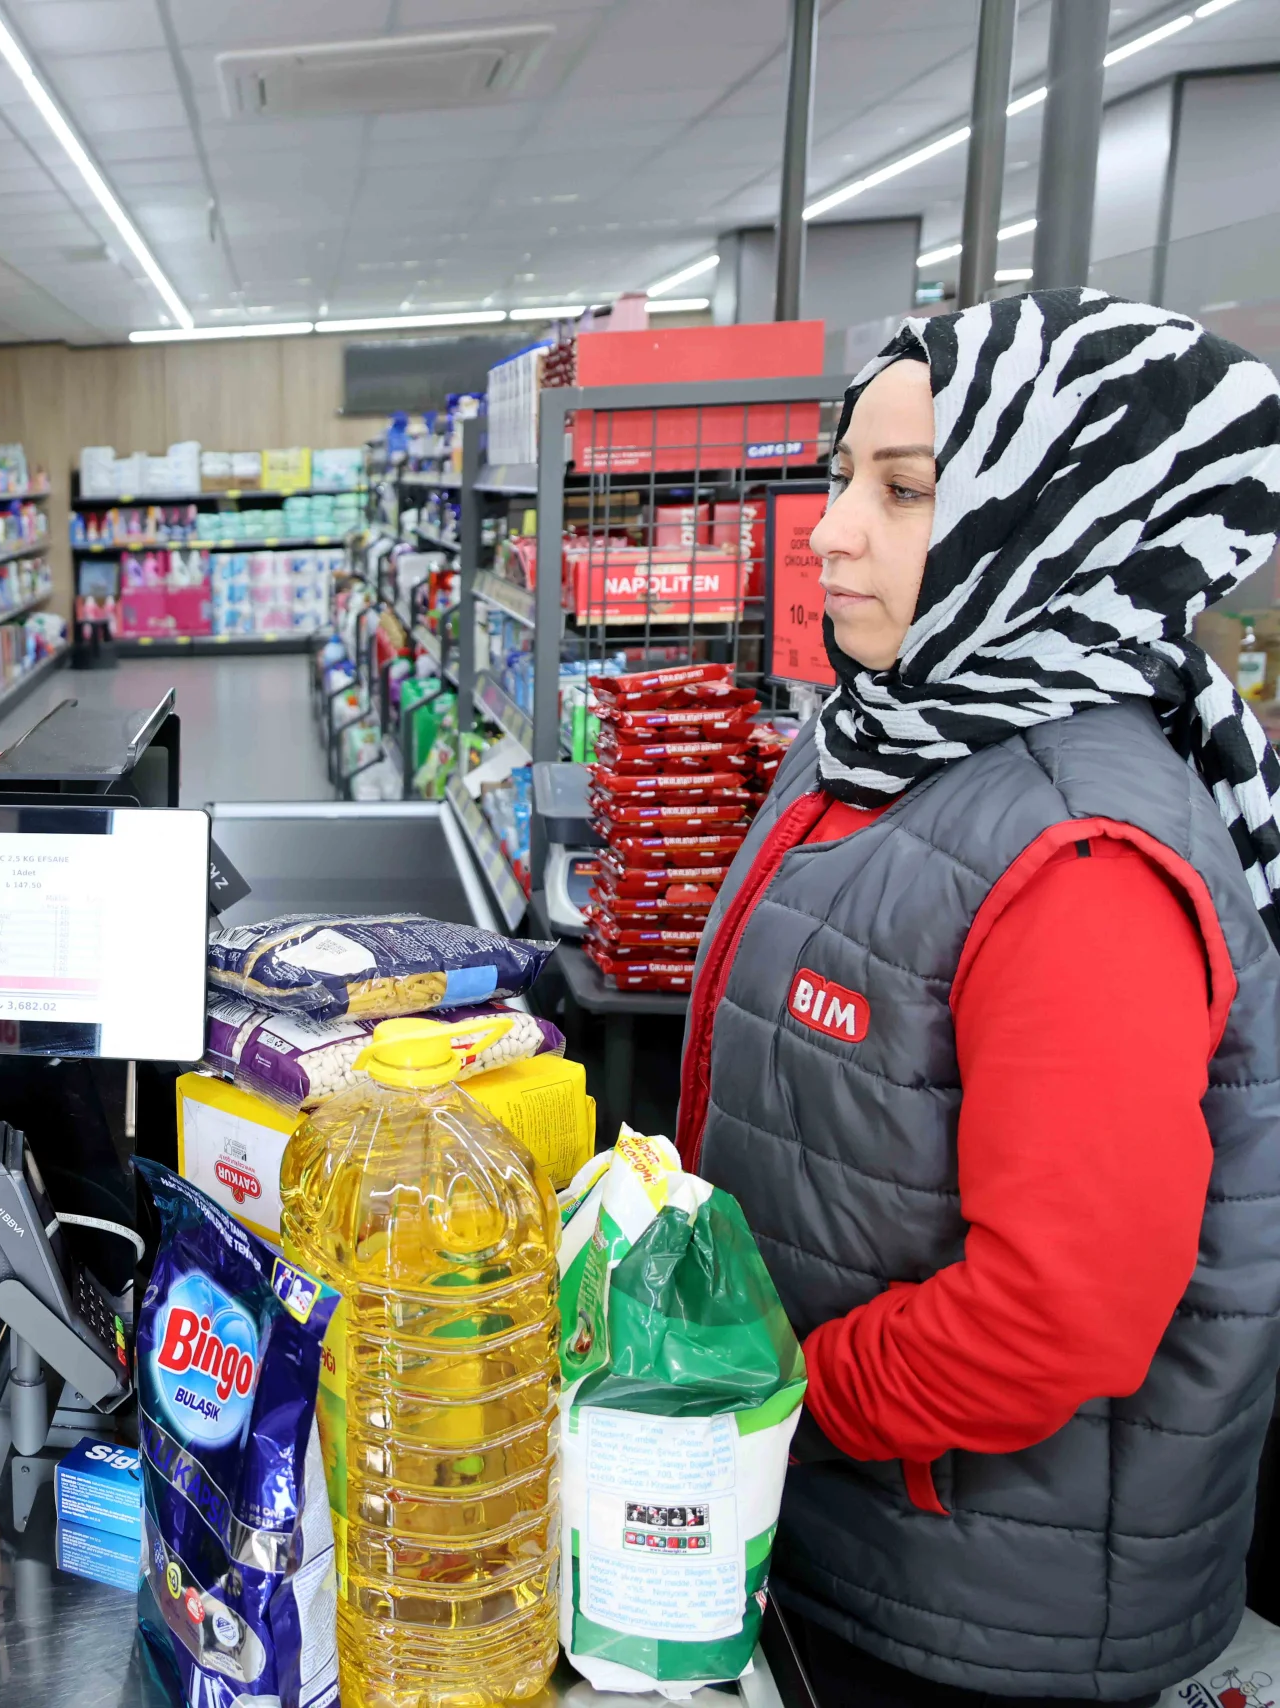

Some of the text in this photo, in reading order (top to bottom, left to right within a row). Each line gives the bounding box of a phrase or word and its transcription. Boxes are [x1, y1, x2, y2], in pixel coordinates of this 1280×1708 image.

[784, 554, 823, 567] ÇİKOLATAL
[605, 575, 719, 594] NAPOLİTEN
[23, 855, 35, 863] KG
[12, 869, 36, 877] 1Adet
[13, 881, 42, 889] 147.50
[7, 1002, 57, 1012] 3,682.02
[217, 1165, 258, 1194] ÇAYKUR
[1, 1213, 25, 1238] BBVA
[157, 1307, 253, 1401] Bingo
[321, 1346, 336, 1376] AĞI
[174, 1387, 220, 1422] BULAŞIK
